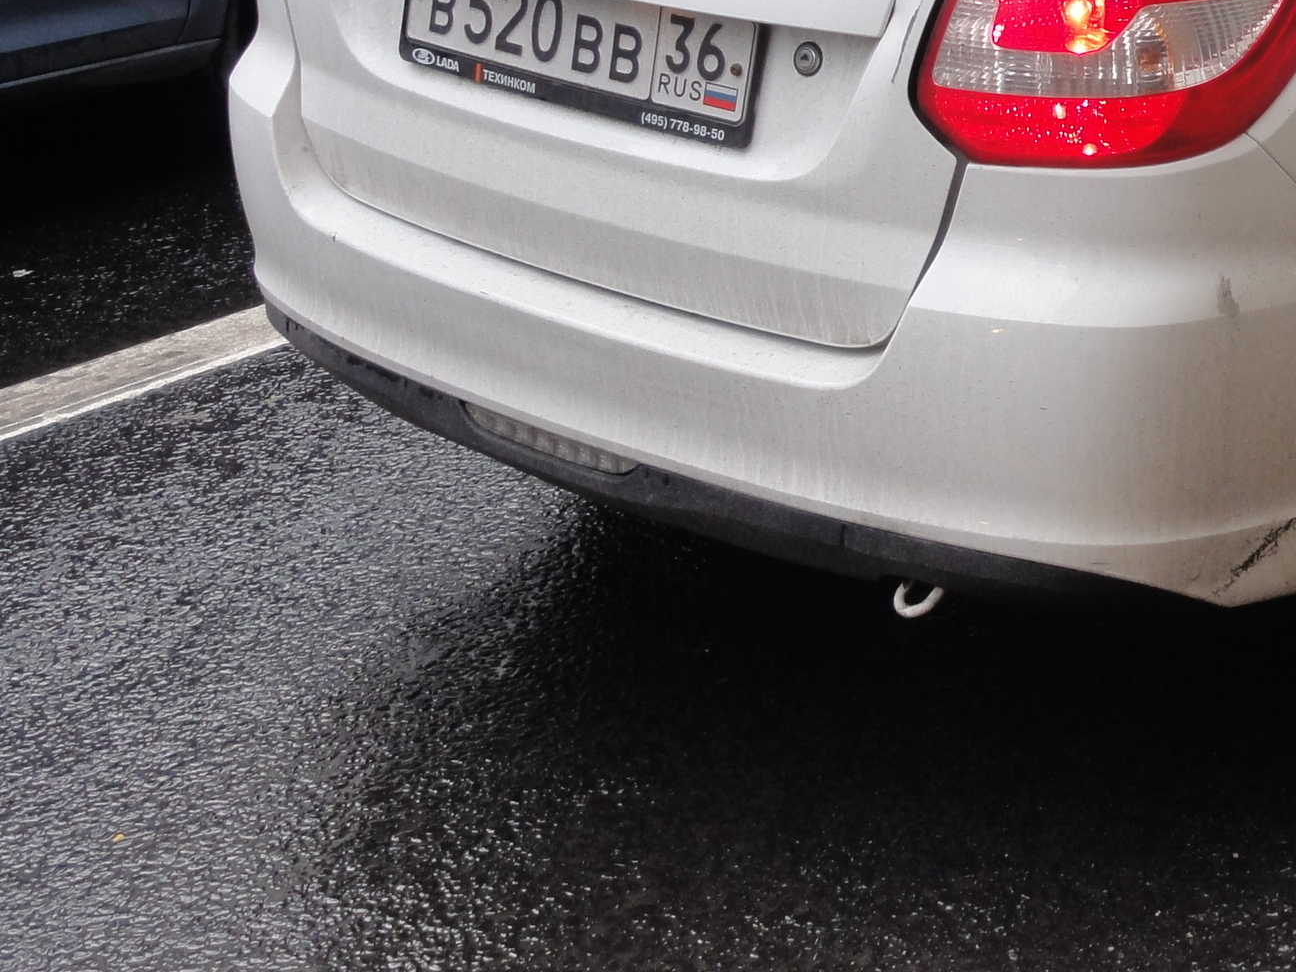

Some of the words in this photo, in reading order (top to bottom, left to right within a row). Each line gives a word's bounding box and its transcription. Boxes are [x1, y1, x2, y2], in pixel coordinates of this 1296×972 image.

[665, 13, 725, 81] 36
[436, 55, 460, 72] LADA
[483, 69, 536, 94] ТЕХИНКОМ
[657, 72, 703, 101] RUS
[641, 111, 668, 130] (495)
[669, 118, 725, 141] 778-98-50
